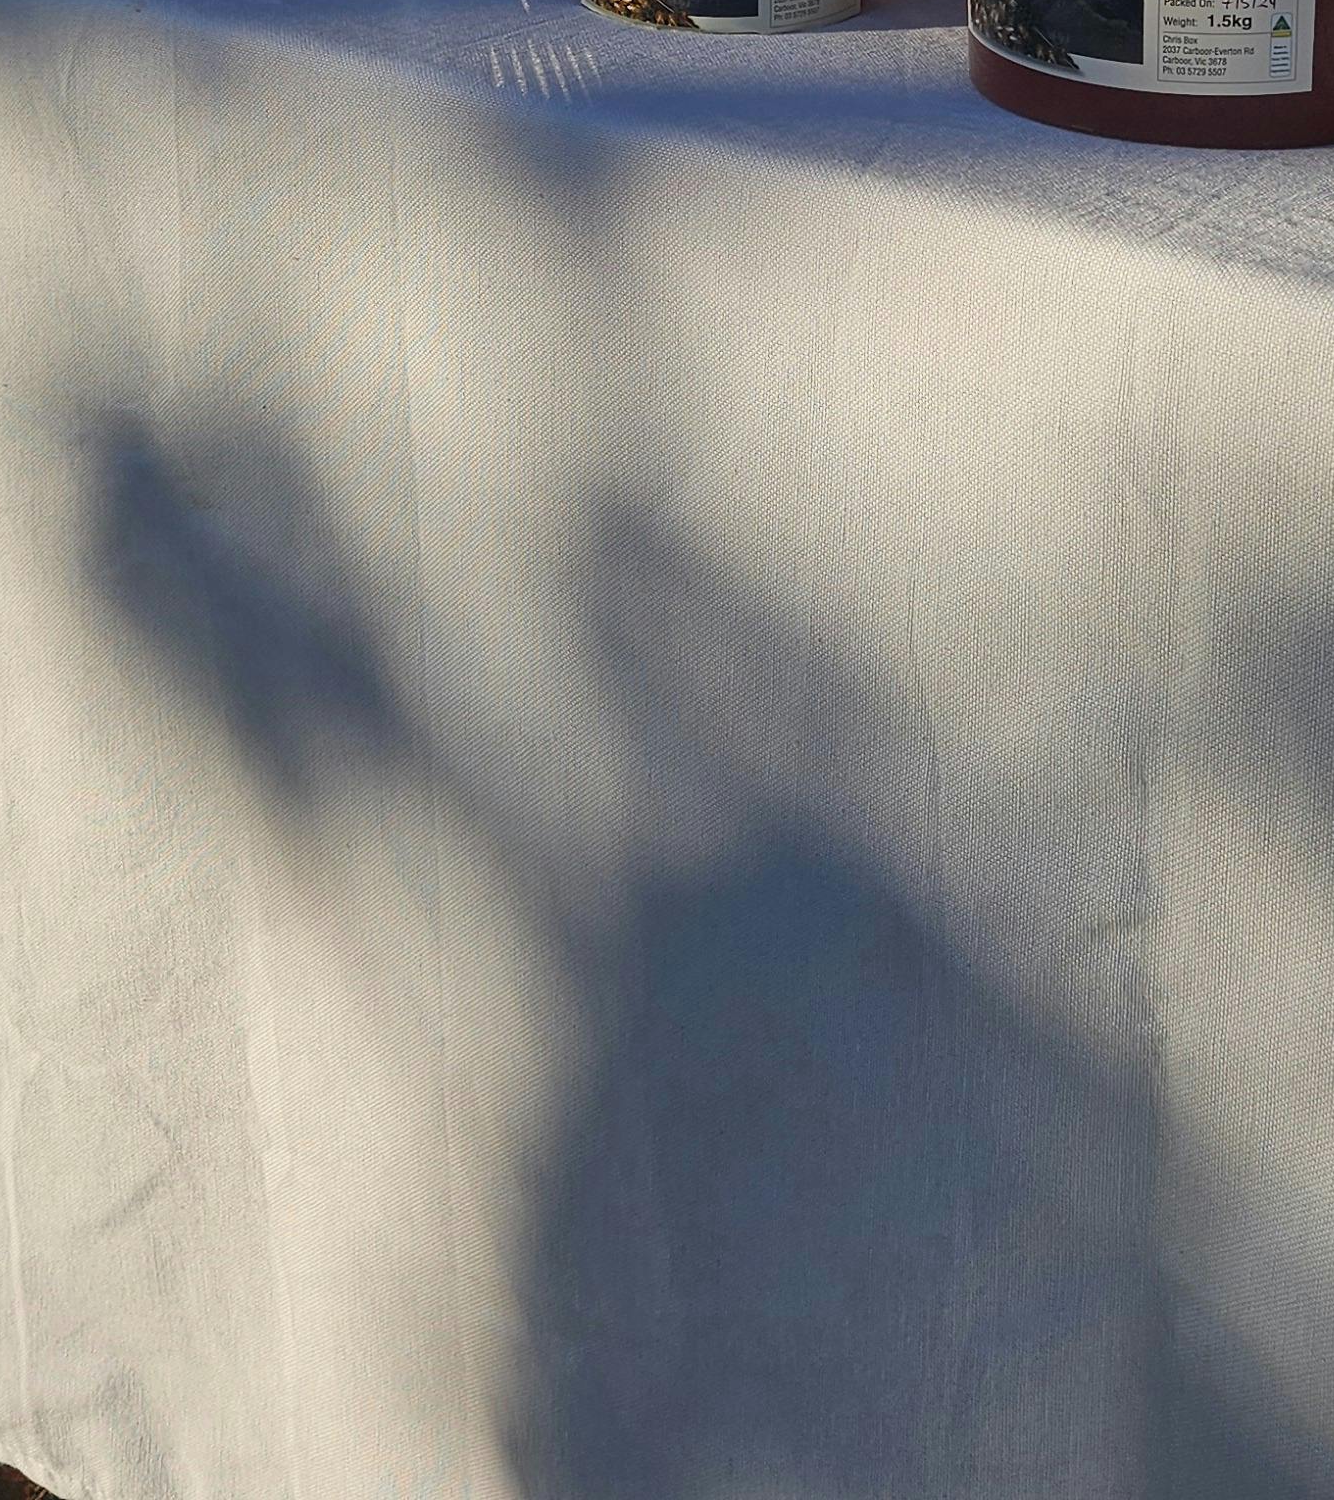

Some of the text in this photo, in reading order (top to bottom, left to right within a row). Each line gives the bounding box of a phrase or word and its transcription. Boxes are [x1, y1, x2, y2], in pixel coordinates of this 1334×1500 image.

[1163, 14, 1252, 30] Weight: 1.5kg
[1163, 34, 1182, 44] Chris
[1162, 46, 1181, 54] 2037
